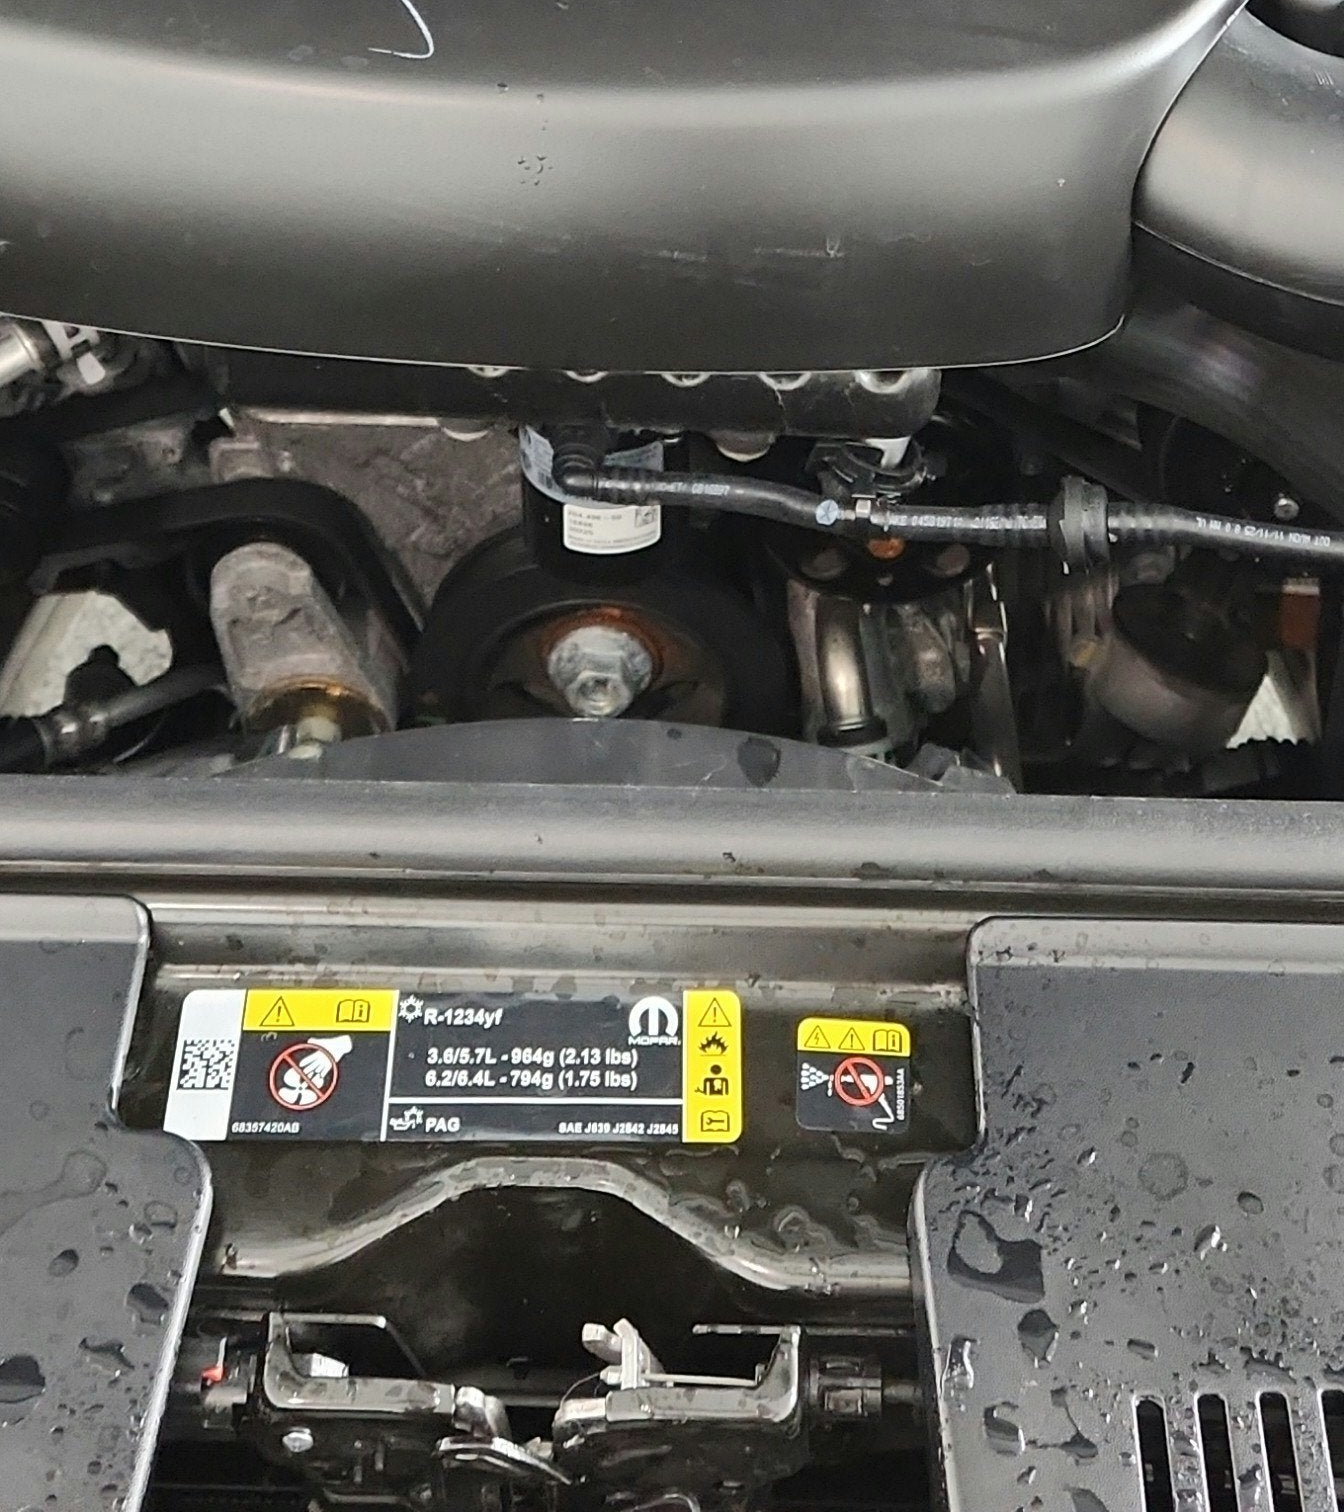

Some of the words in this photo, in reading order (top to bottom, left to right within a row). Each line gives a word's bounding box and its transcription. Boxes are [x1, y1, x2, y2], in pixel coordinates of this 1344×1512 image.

[424, 1008, 504, 1029] R-1234yf
[427, 1047, 498, 1065] 3.6/5.7L
[510, 1048, 555, 1068] 964g
[559, 1047, 602, 1068] (2.13
[605, 1048, 639, 1069] lbs)
[425, 1069, 496, 1087] 6.2/6.4L
[510, 1070, 554, 1090] 794g
[558, 1070, 602, 1090] (1.75
[605, 1070, 638, 1091] lbs)
[424, 1117, 460, 1133] PAG
[558, 1122, 582, 1134] SAE
